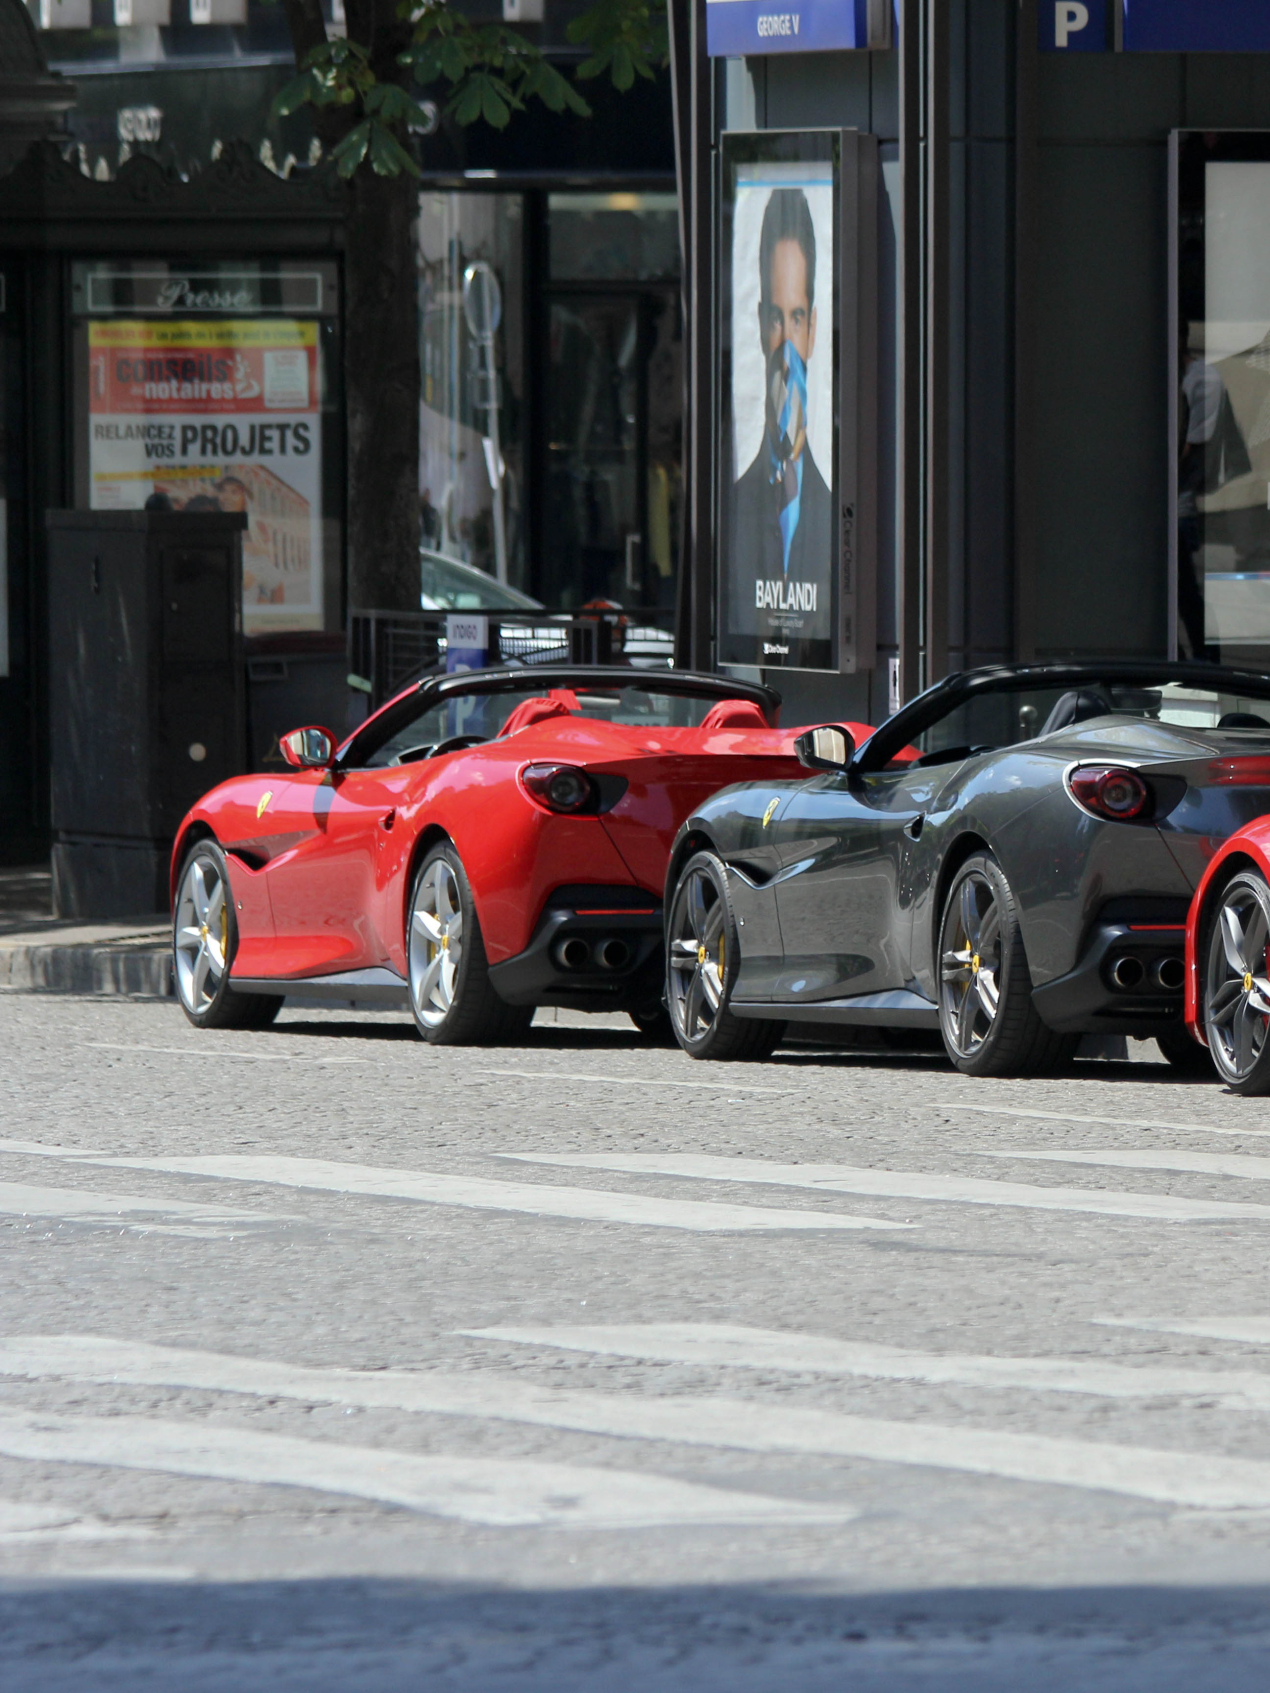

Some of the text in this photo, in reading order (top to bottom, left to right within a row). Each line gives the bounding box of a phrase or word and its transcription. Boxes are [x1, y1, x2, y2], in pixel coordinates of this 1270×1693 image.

[757, 14, 800, 37] GEORGE V
[1055, 2, 1090, 48] P
[157, 279, 252, 308] Presse
[115, 353, 229, 384] conseils
[144, 377, 234, 400] notaires
[94, 423, 176, 441] RELANCEZ
[180, 422, 312, 458] PROJETS
[143, 443, 176, 459] VOS
[755, 579, 818, 612] BAYLANDI
